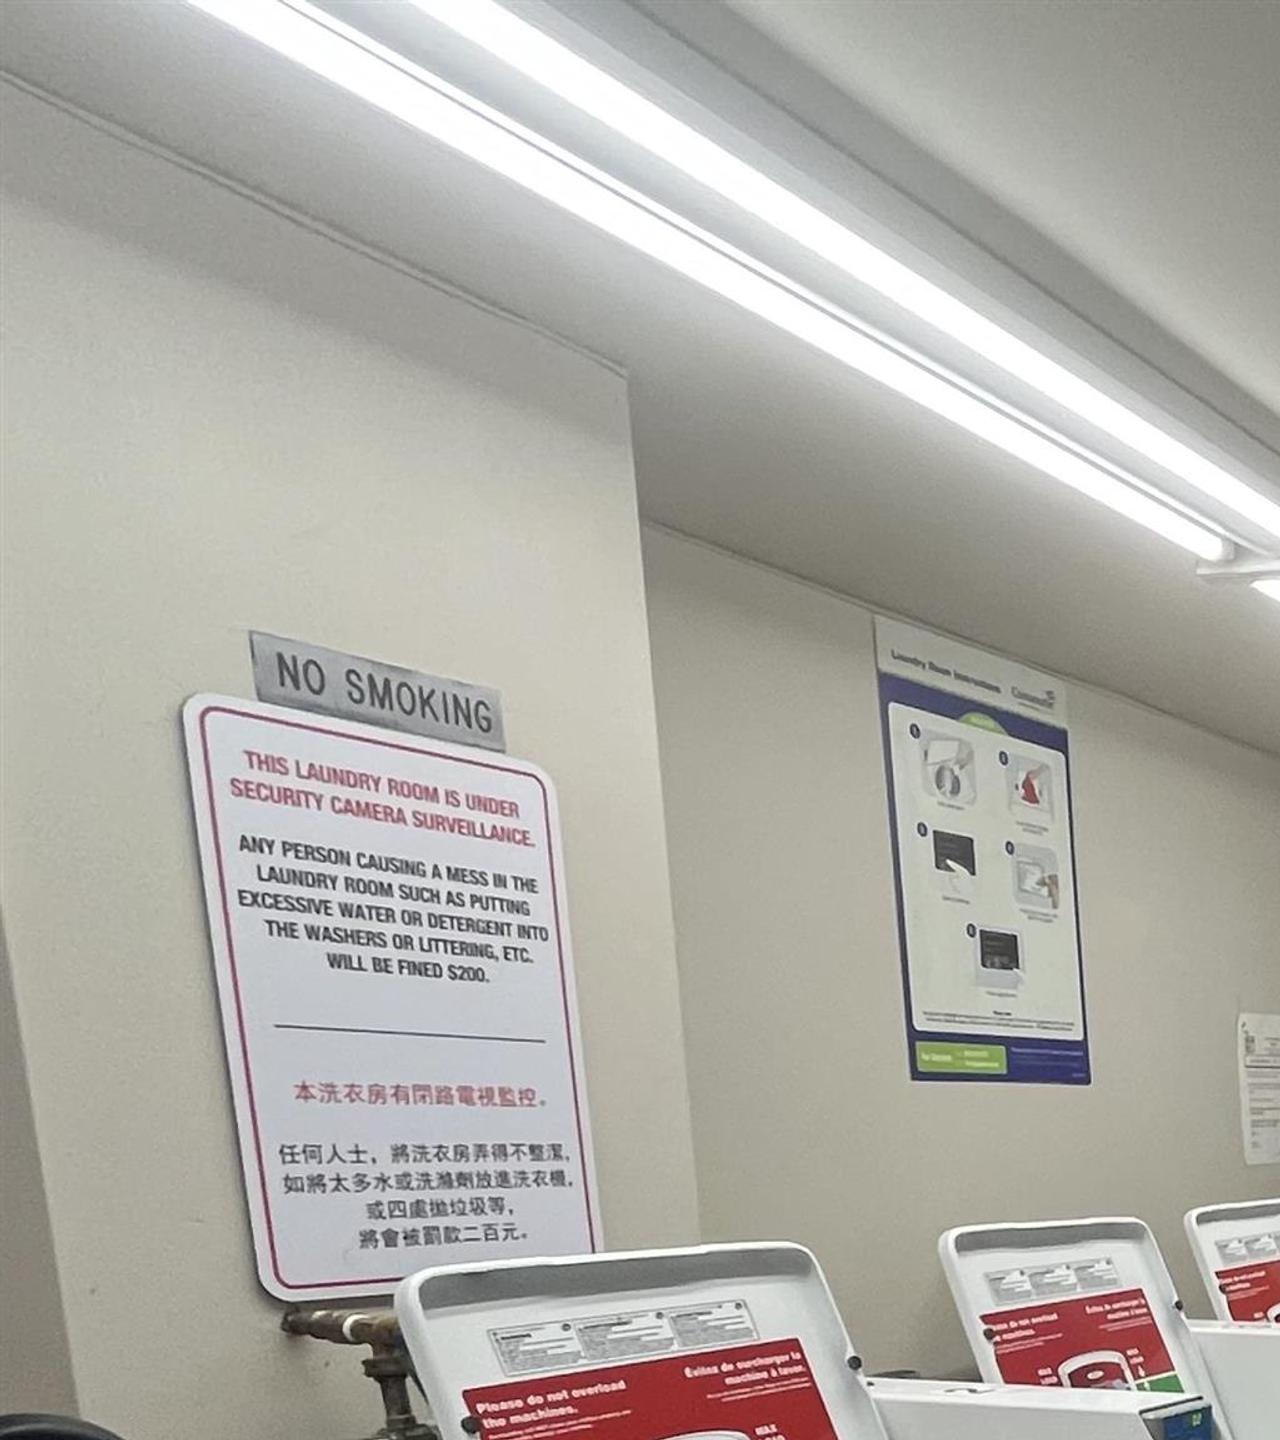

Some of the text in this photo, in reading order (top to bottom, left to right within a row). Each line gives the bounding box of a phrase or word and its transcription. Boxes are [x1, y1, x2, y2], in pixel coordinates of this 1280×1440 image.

[277, 652, 493, 733] NO SMOKING
[243, 750, 520, 819] THIS LAUNDRY ROOM IS UNDER
[230, 778, 537, 848] SECURITY CAMERA SURVEILLANCE.
[239, 834, 538, 894] ANY PERSON CAUSING A MESS IN THE
[237, 889, 549, 943] EXCESSIVE WATER OR DETERGENT INTO
[256, 865, 531, 917] LAUNDRY ROOM SUCH AS PUTTING
[266, 920, 534, 964] THE WASHERS OR LITTERING, ETC.
[327, 952, 490, 983] WILL BE FINED $200.
[476, 1379, 626, 1414] Please do not overload
[482, 1414, 507, 1430] the
[509, 1404, 579, 1426] machines.
